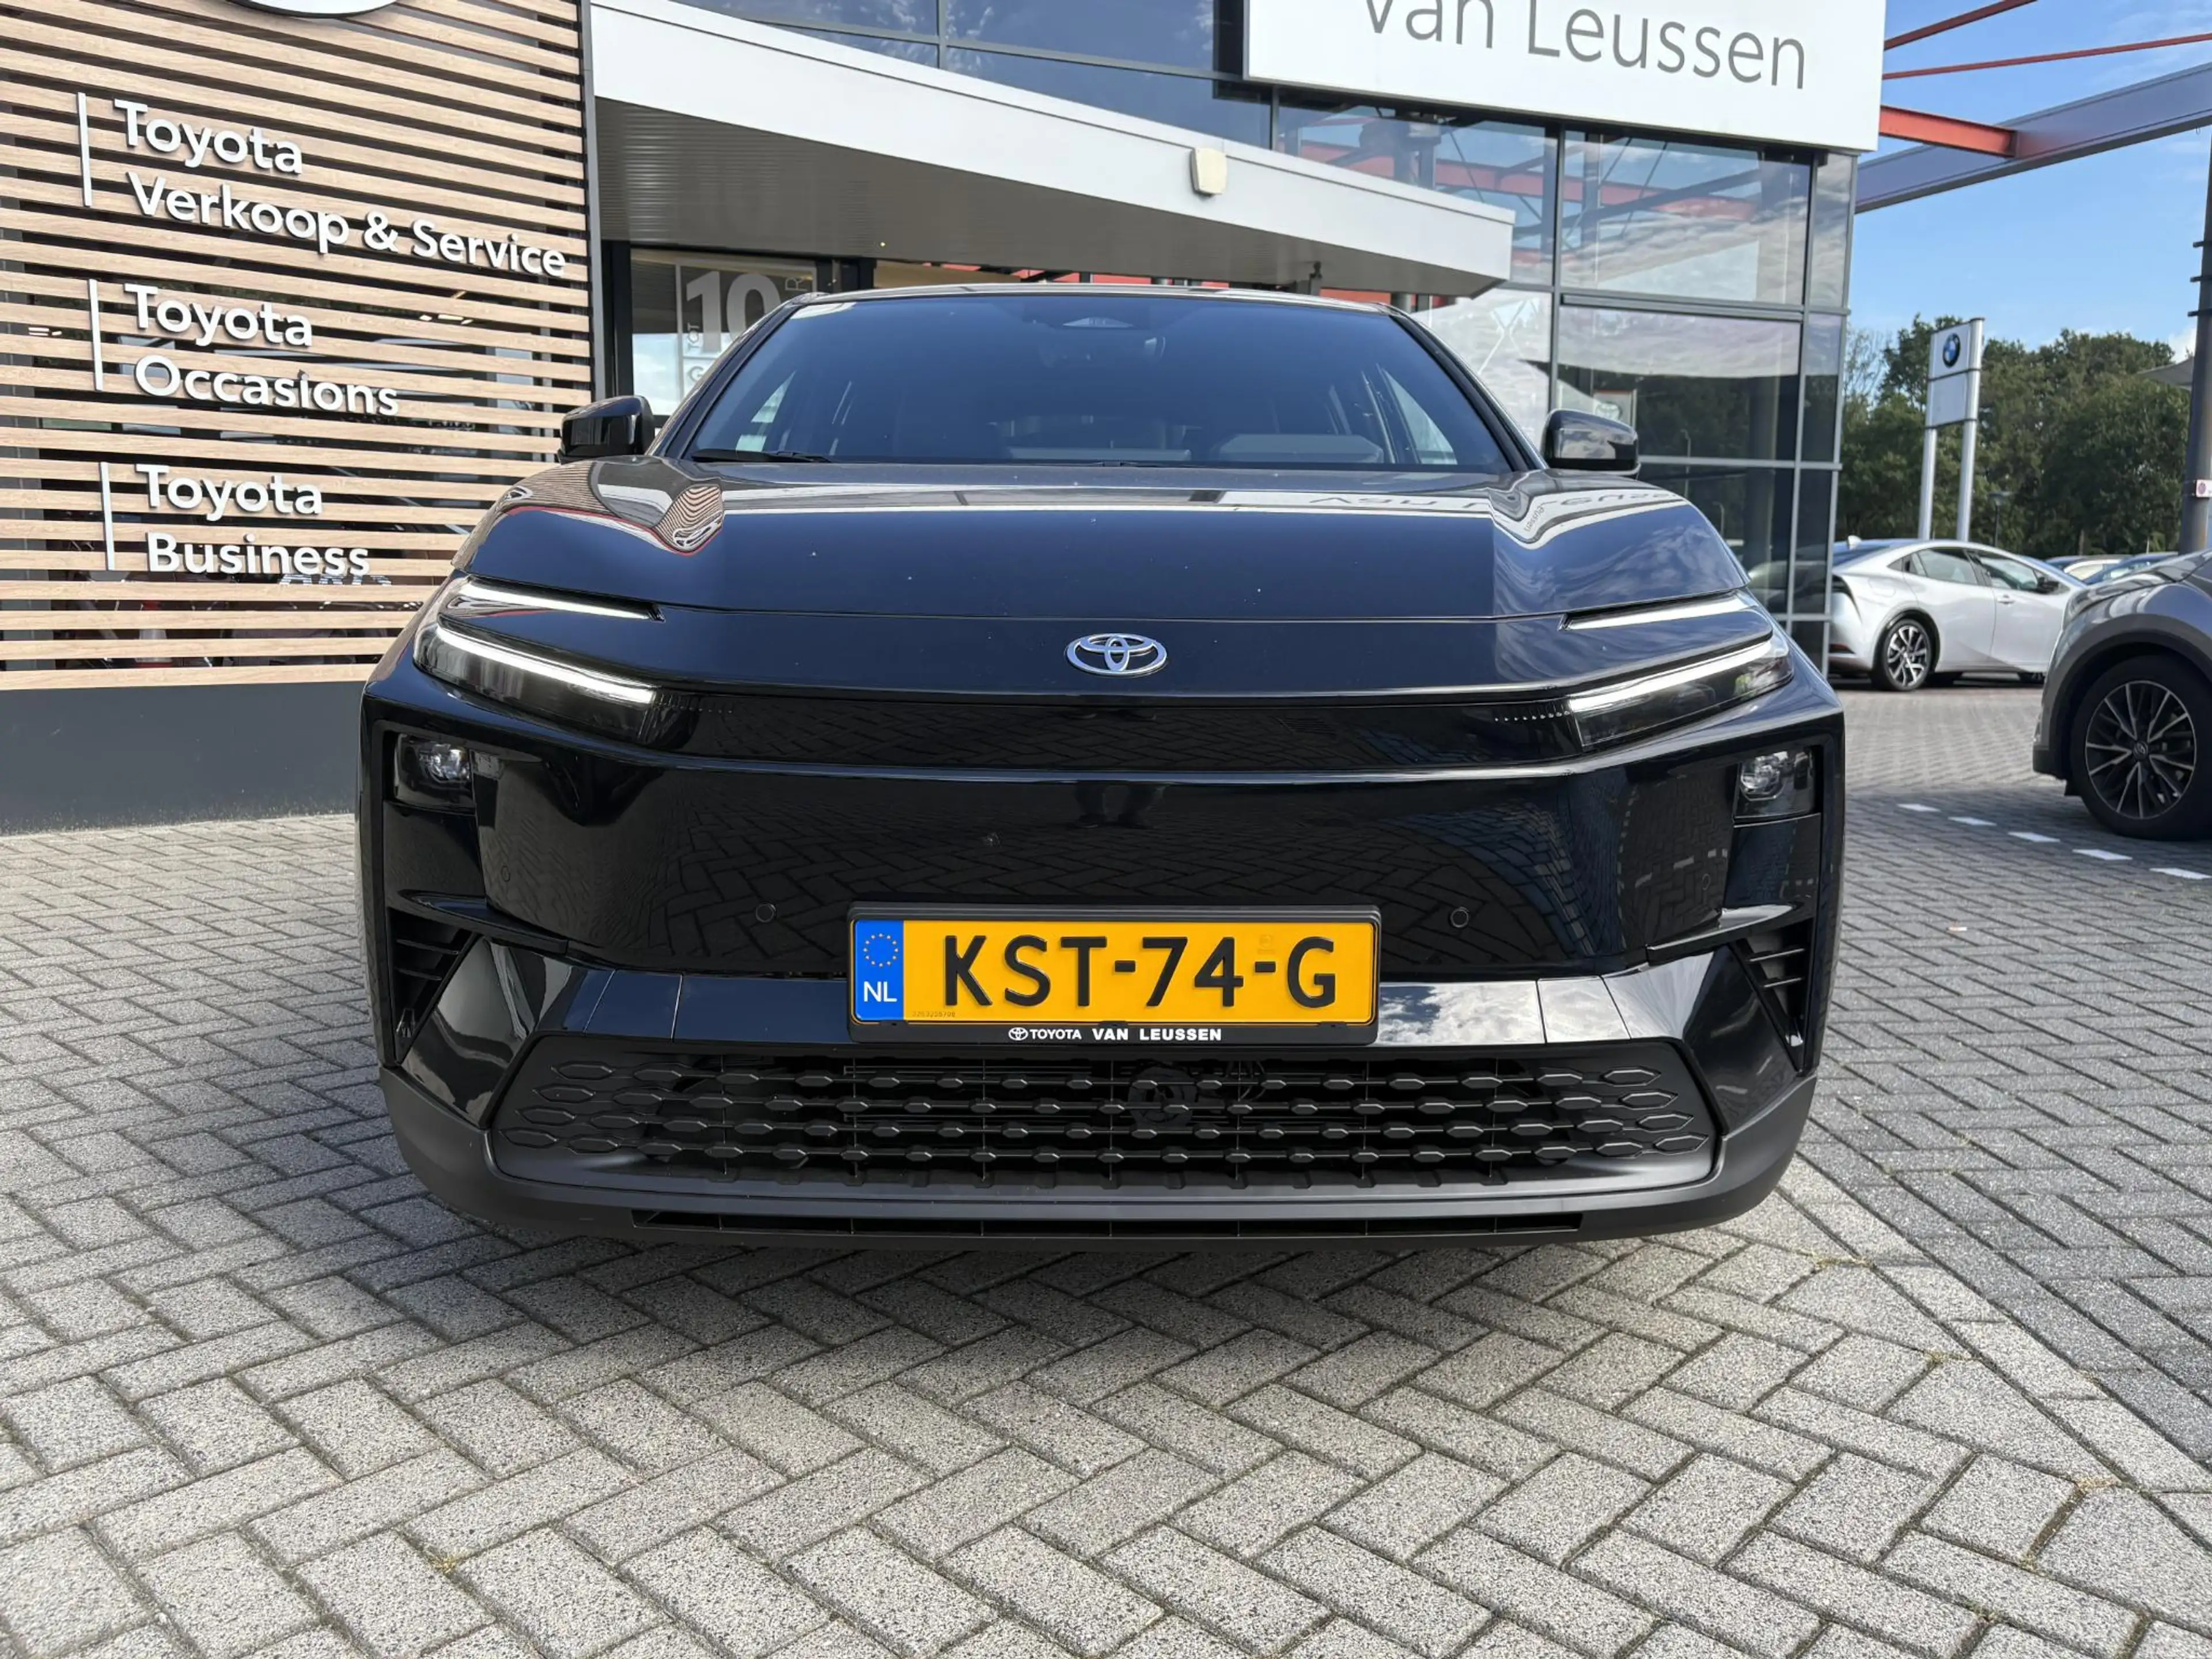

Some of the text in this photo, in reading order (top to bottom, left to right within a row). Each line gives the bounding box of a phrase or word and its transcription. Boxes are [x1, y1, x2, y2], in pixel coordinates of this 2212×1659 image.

[1528, 0, 1805, 89] Leussen
[113, 99, 302, 174] Toyota
[126, 172, 566, 277] Verkoop & Service
[123, 283, 312, 347] Toyota
[134, 354, 399, 416] Occasions
[135, 463, 323, 521] Toyota
[146, 532, 371, 575] Business
[863, 982, 897, 1003] NL
[944, 934, 1336, 1008] KST-74-G
[1029, 1028, 1222, 1041] TOYOTA VAN LEUSSEN
